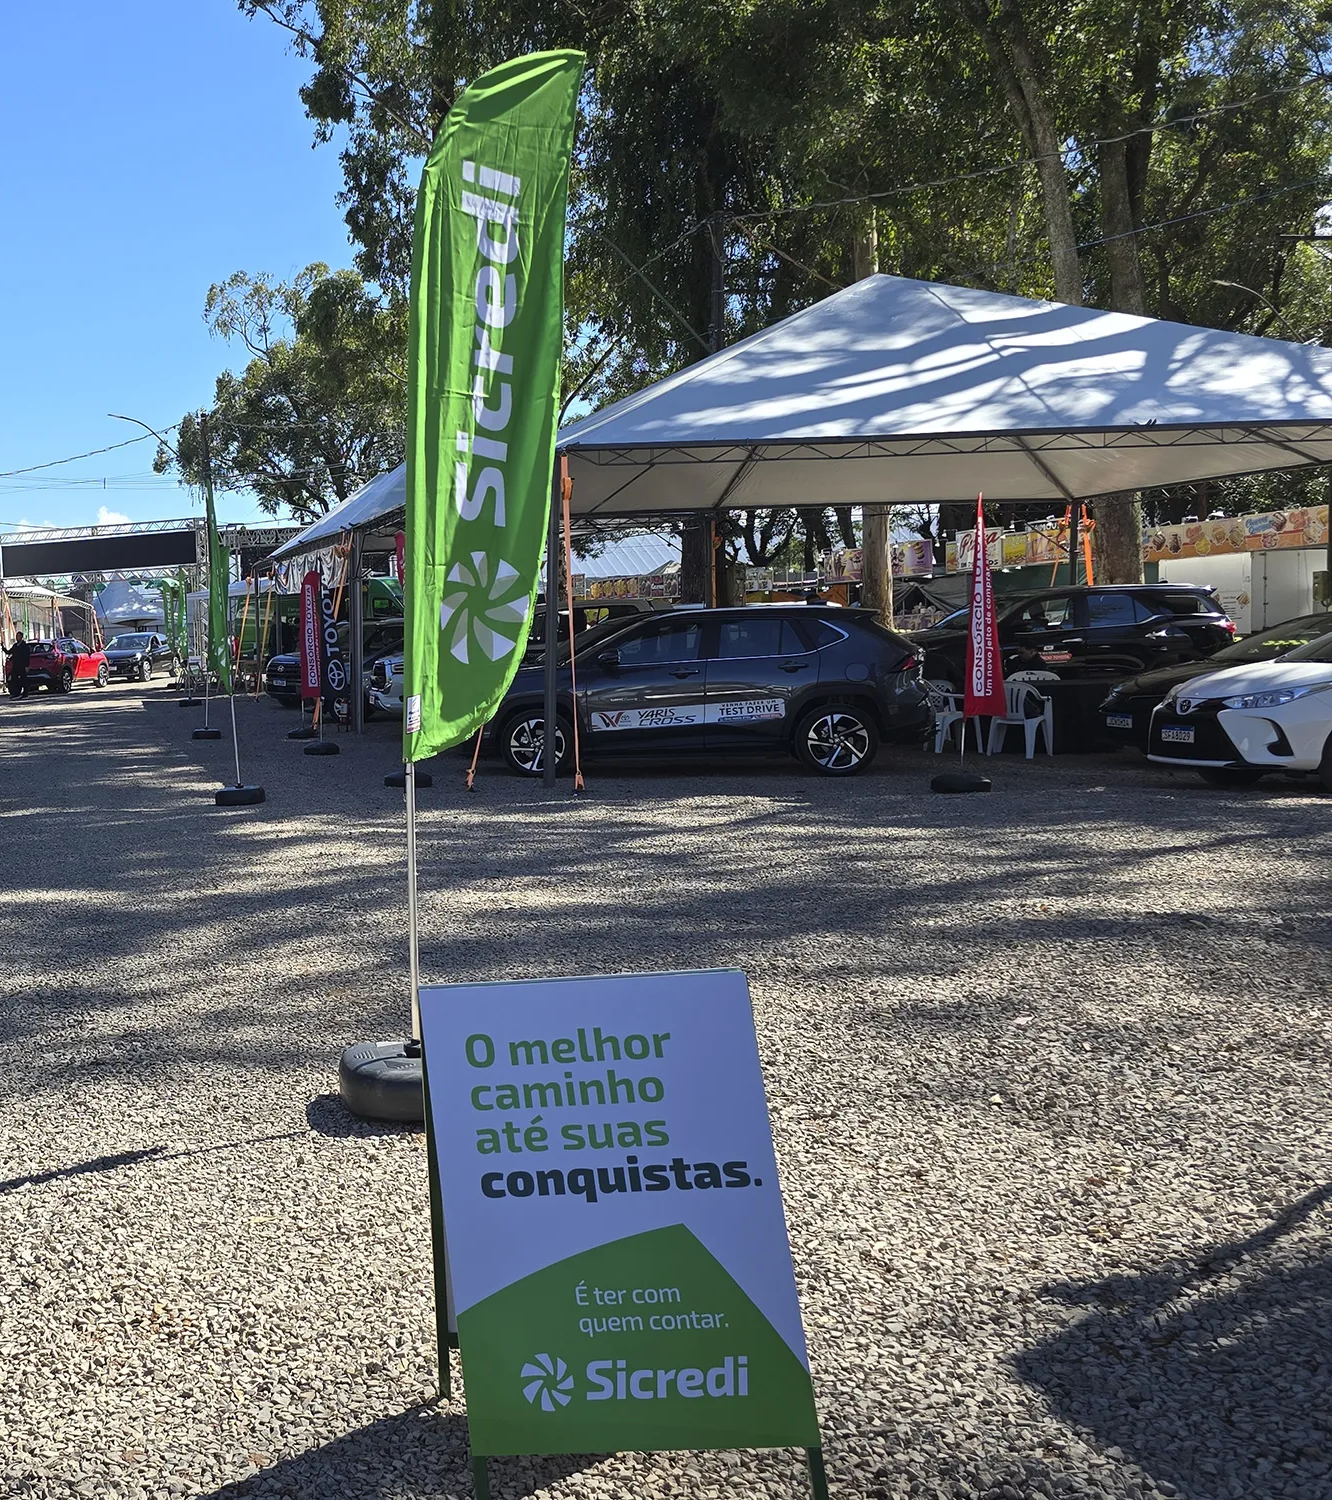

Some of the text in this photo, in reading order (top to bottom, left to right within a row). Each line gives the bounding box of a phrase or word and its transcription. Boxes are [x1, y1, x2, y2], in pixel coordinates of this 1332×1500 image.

[456, 160, 521, 527] Sicredi
[960, 532, 1000, 558] Pia
[985, 567, 993, 610] comprar
[321, 574, 340, 657] TOYOTA
[985, 612, 992, 624] de
[307, 628, 318, 686] CONSÓRCIO
[974, 592, 983, 693] CONSÓRCIO
[985, 681, 993, 696] Um
[638, 708, 676, 719] YARIS
[639, 715, 697, 727] CROSS
[719, 707, 744, 716] TEST
[746, 704, 780, 714] DRIVE
[465, 1027, 670, 1068] O melhor
[471, 1069, 664, 1111] caminho
[475, 1114, 669, 1155] até suas
[480, 1155, 763, 1203] conquistas.
[575, 1280, 681, 1306] É ter com
[579, 1310, 729, 1338] quem contar.
[586, 1355, 749, 1401] Sicredi
